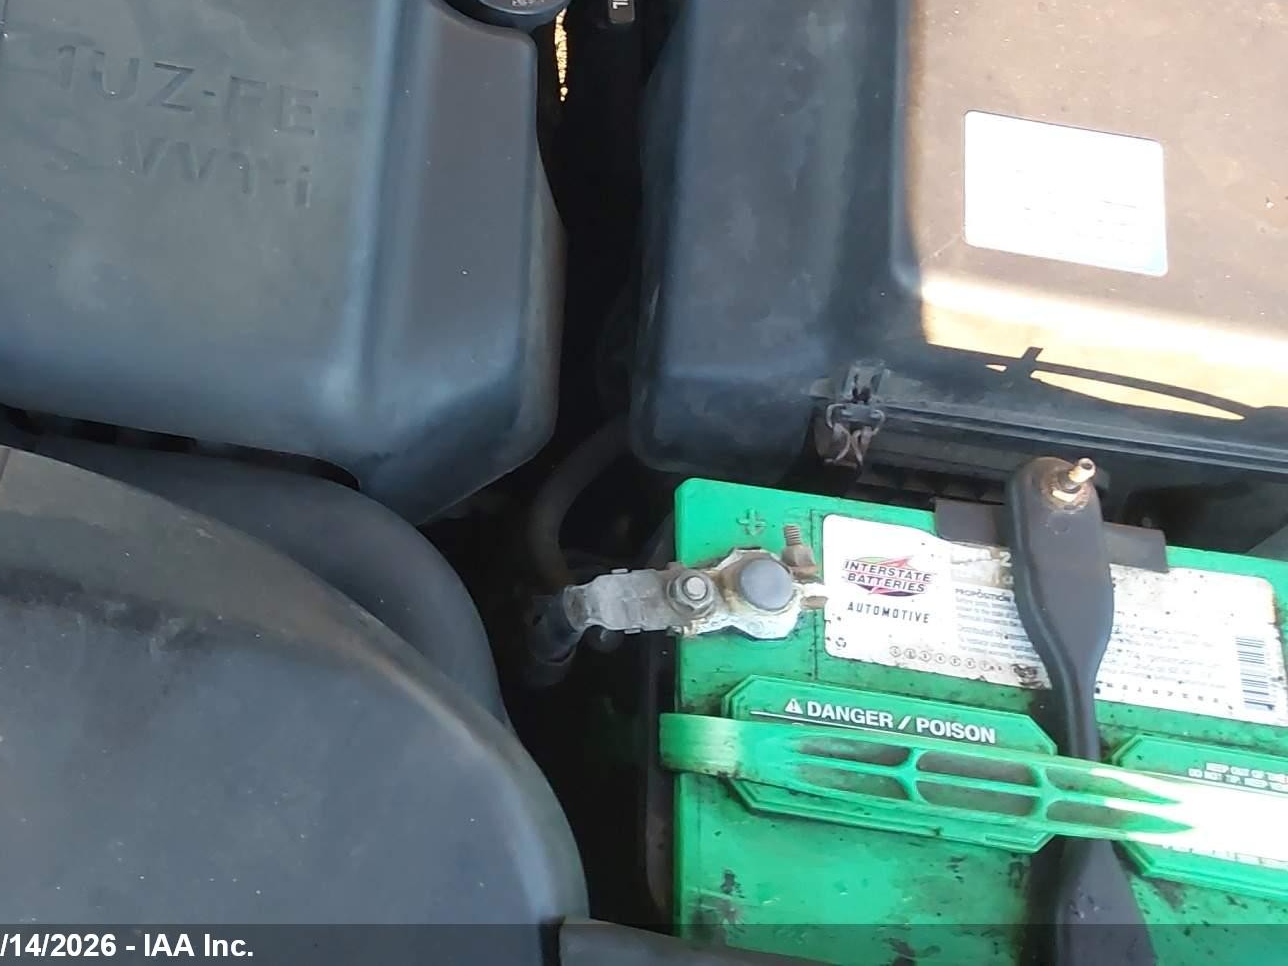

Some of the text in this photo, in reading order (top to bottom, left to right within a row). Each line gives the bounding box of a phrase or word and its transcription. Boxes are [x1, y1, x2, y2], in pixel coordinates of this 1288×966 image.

[57, 44, 320, 136] 1UZ-FE
[844, 560, 932, 583] INTERSTATE
[847, 572, 926, 593] BATTERIES
[847, 601, 931, 624] AUTOMOTIVE
[807, 700, 996, 744] DANGER / POISON
